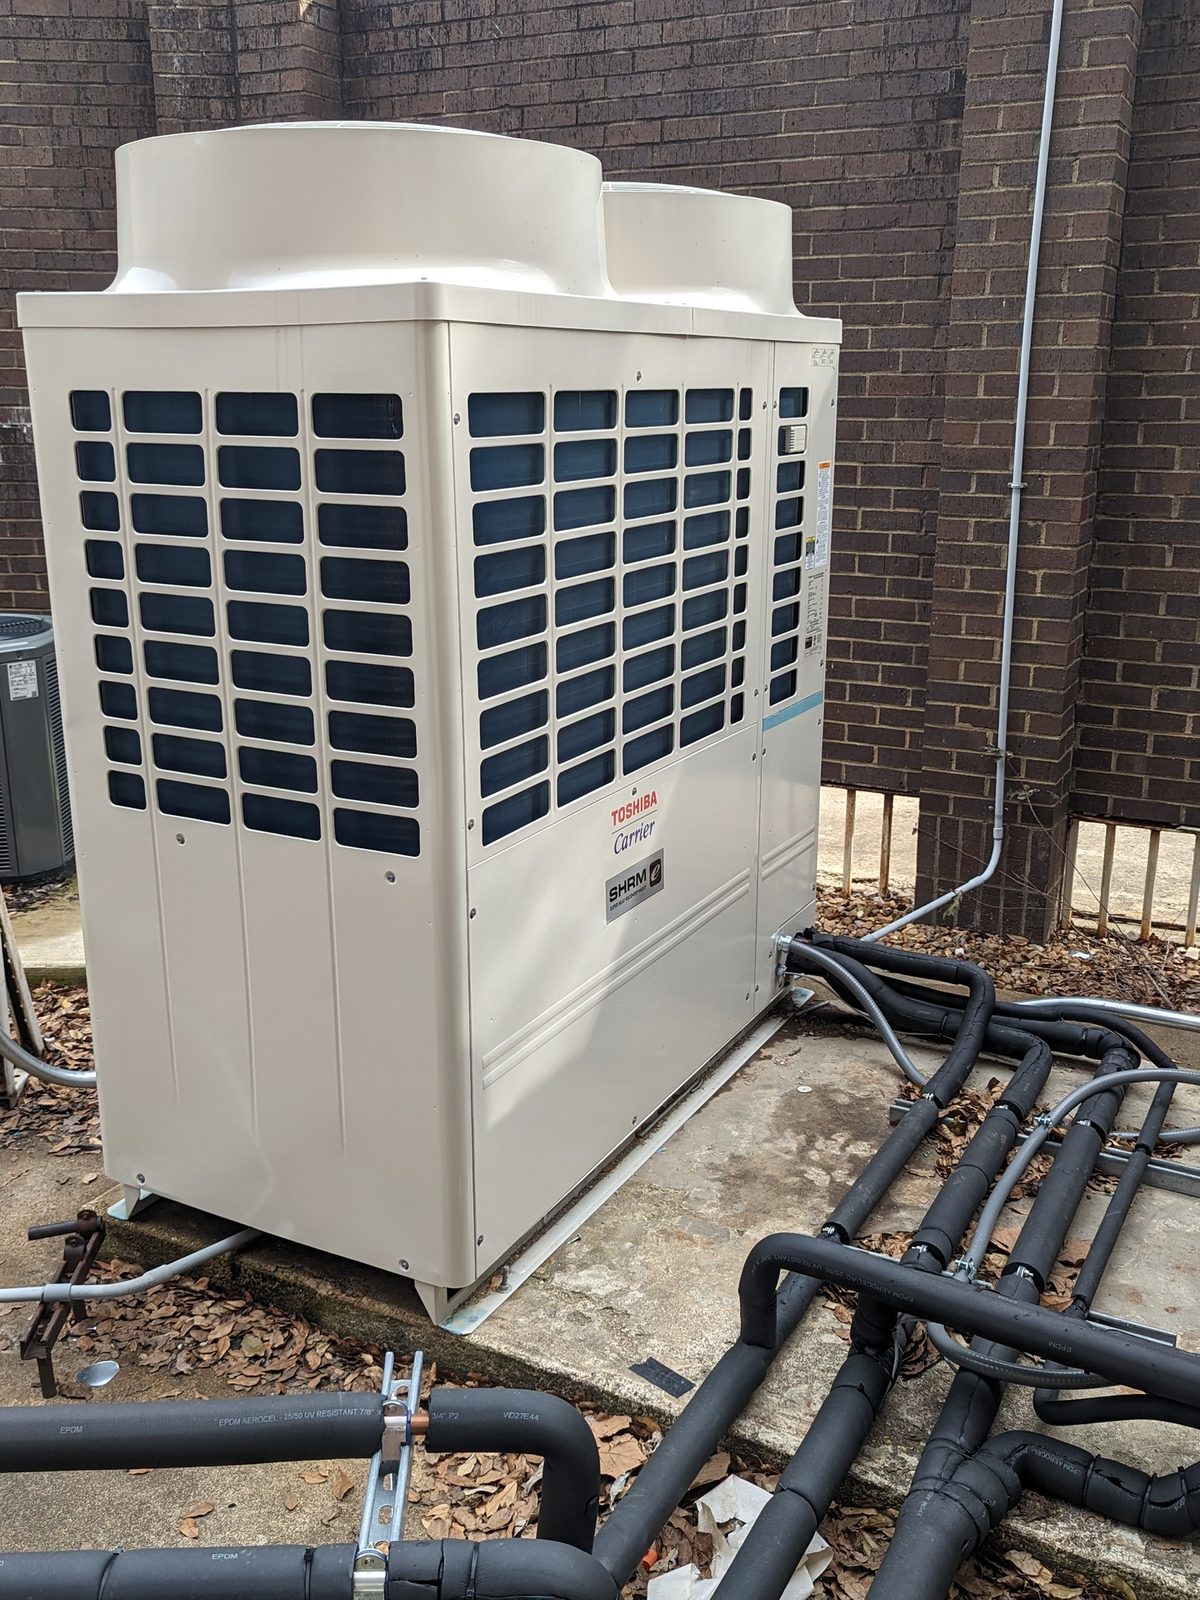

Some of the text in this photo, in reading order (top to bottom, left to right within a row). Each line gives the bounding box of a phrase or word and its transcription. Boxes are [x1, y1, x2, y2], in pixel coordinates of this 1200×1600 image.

[611, 791, 657, 826] TOSHIBA
[613, 821, 655, 854] Carrier
[609, 868, 647, 902] SHRM
[1048, 1341, 1072, 1353] EPDM
[60, 1426, 83, 1434] EPDM
[218, 1418, 241, 1427] EPDM
[242, 1415, 278, 1424] AEROCEL
[316, 1408, 358, 1418] RESISTANT
